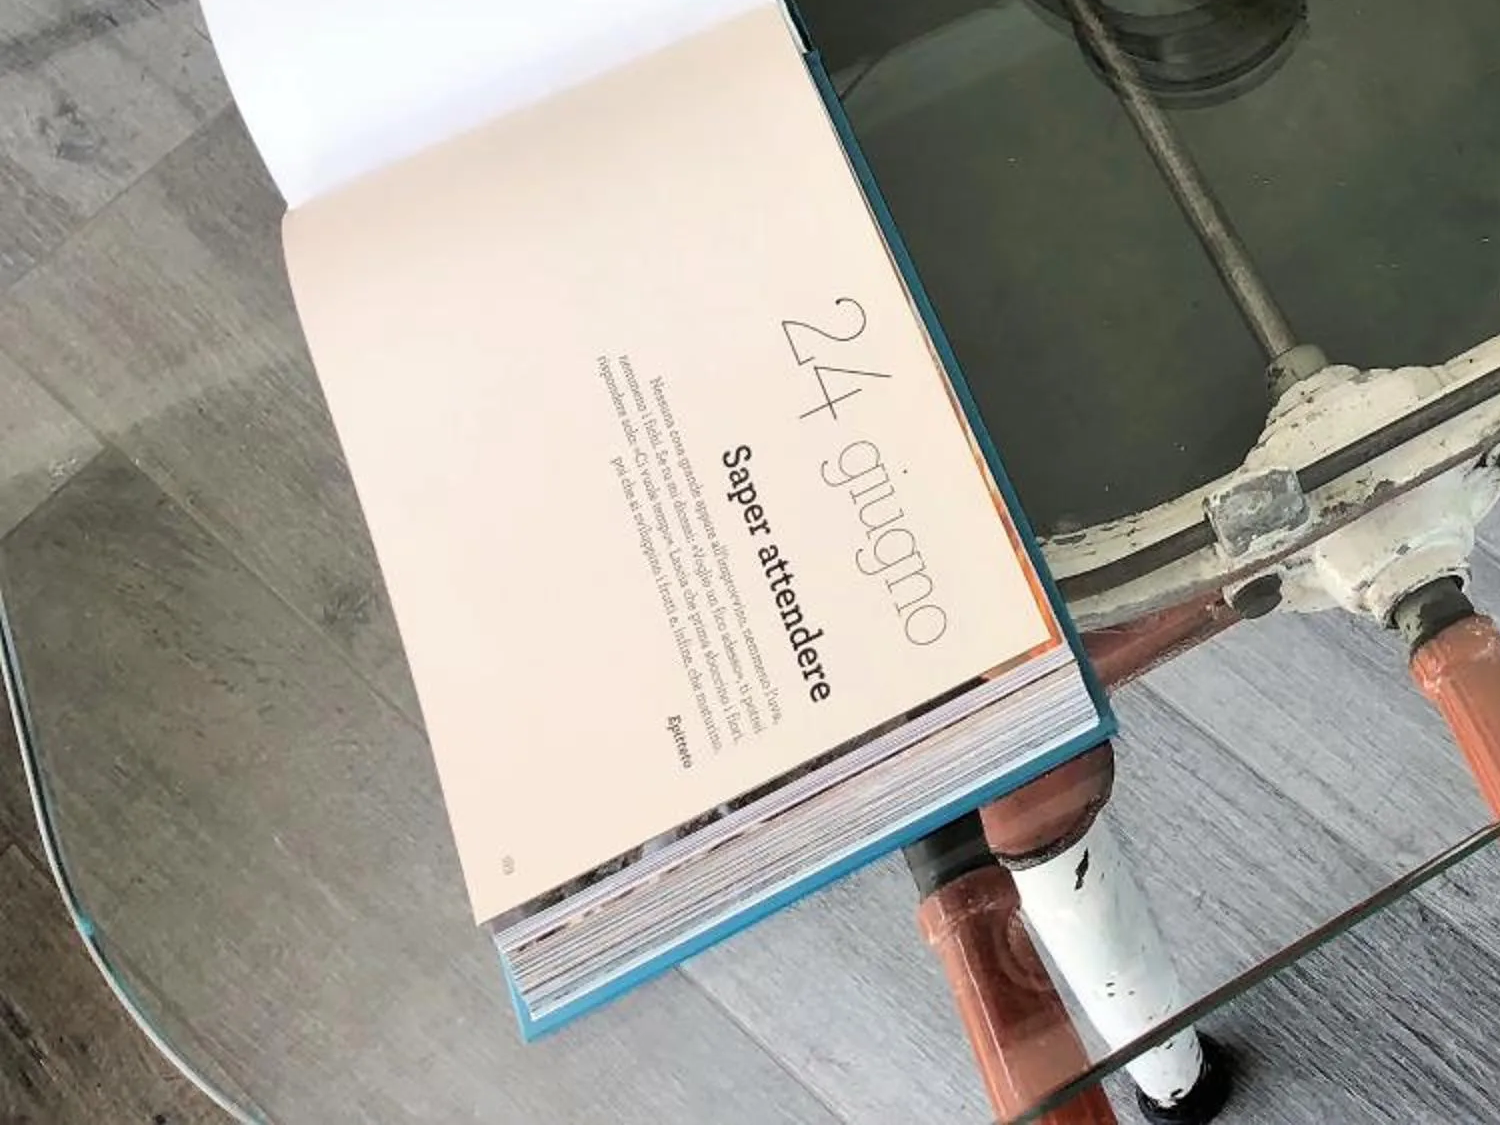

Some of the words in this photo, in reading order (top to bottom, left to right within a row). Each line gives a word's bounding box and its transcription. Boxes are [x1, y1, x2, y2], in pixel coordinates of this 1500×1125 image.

[781, 296, 893, 421] 24
[594, 354, 631, 419] rispondere
[617, 353, 649, 413] nemmeno
[648, 375, 679, 429] Nessuna
[653, 450, 670, 467] Se
[667, 428, 686, 457] cosa
[607, 455, 629, 479] poi
[638, 467, 662, 501] vuole
[676, 455, 705, 501] grande
[618, 476, 638, 500] che
[626, 499, 642, 513] si
[664, 481, 682, 501] mi
[691, 499, 717, 541] appare
[628, 511, 666, 577] sviluppino
[819, 440, 949, 646] giugno
[666, 548, 693, 590] Lascia
[721, 444, 771, 536] Saper
[758, 544, 831, 703] attendere
[655, 581, 680, 617] frutti
[681, 587, 702, 613] che
[703, 589, 719, 608] un
[687, 611, 715, 651] prima
[710, 606, 731, 633] fico
[686, 667, 706, 692] che
[702, 649, 736, 707] sboccino
[740, 628, 772, 691] nemmeno
[738, 684, 752, 696] ti
[665, 713, 694, 770] Epitteto
